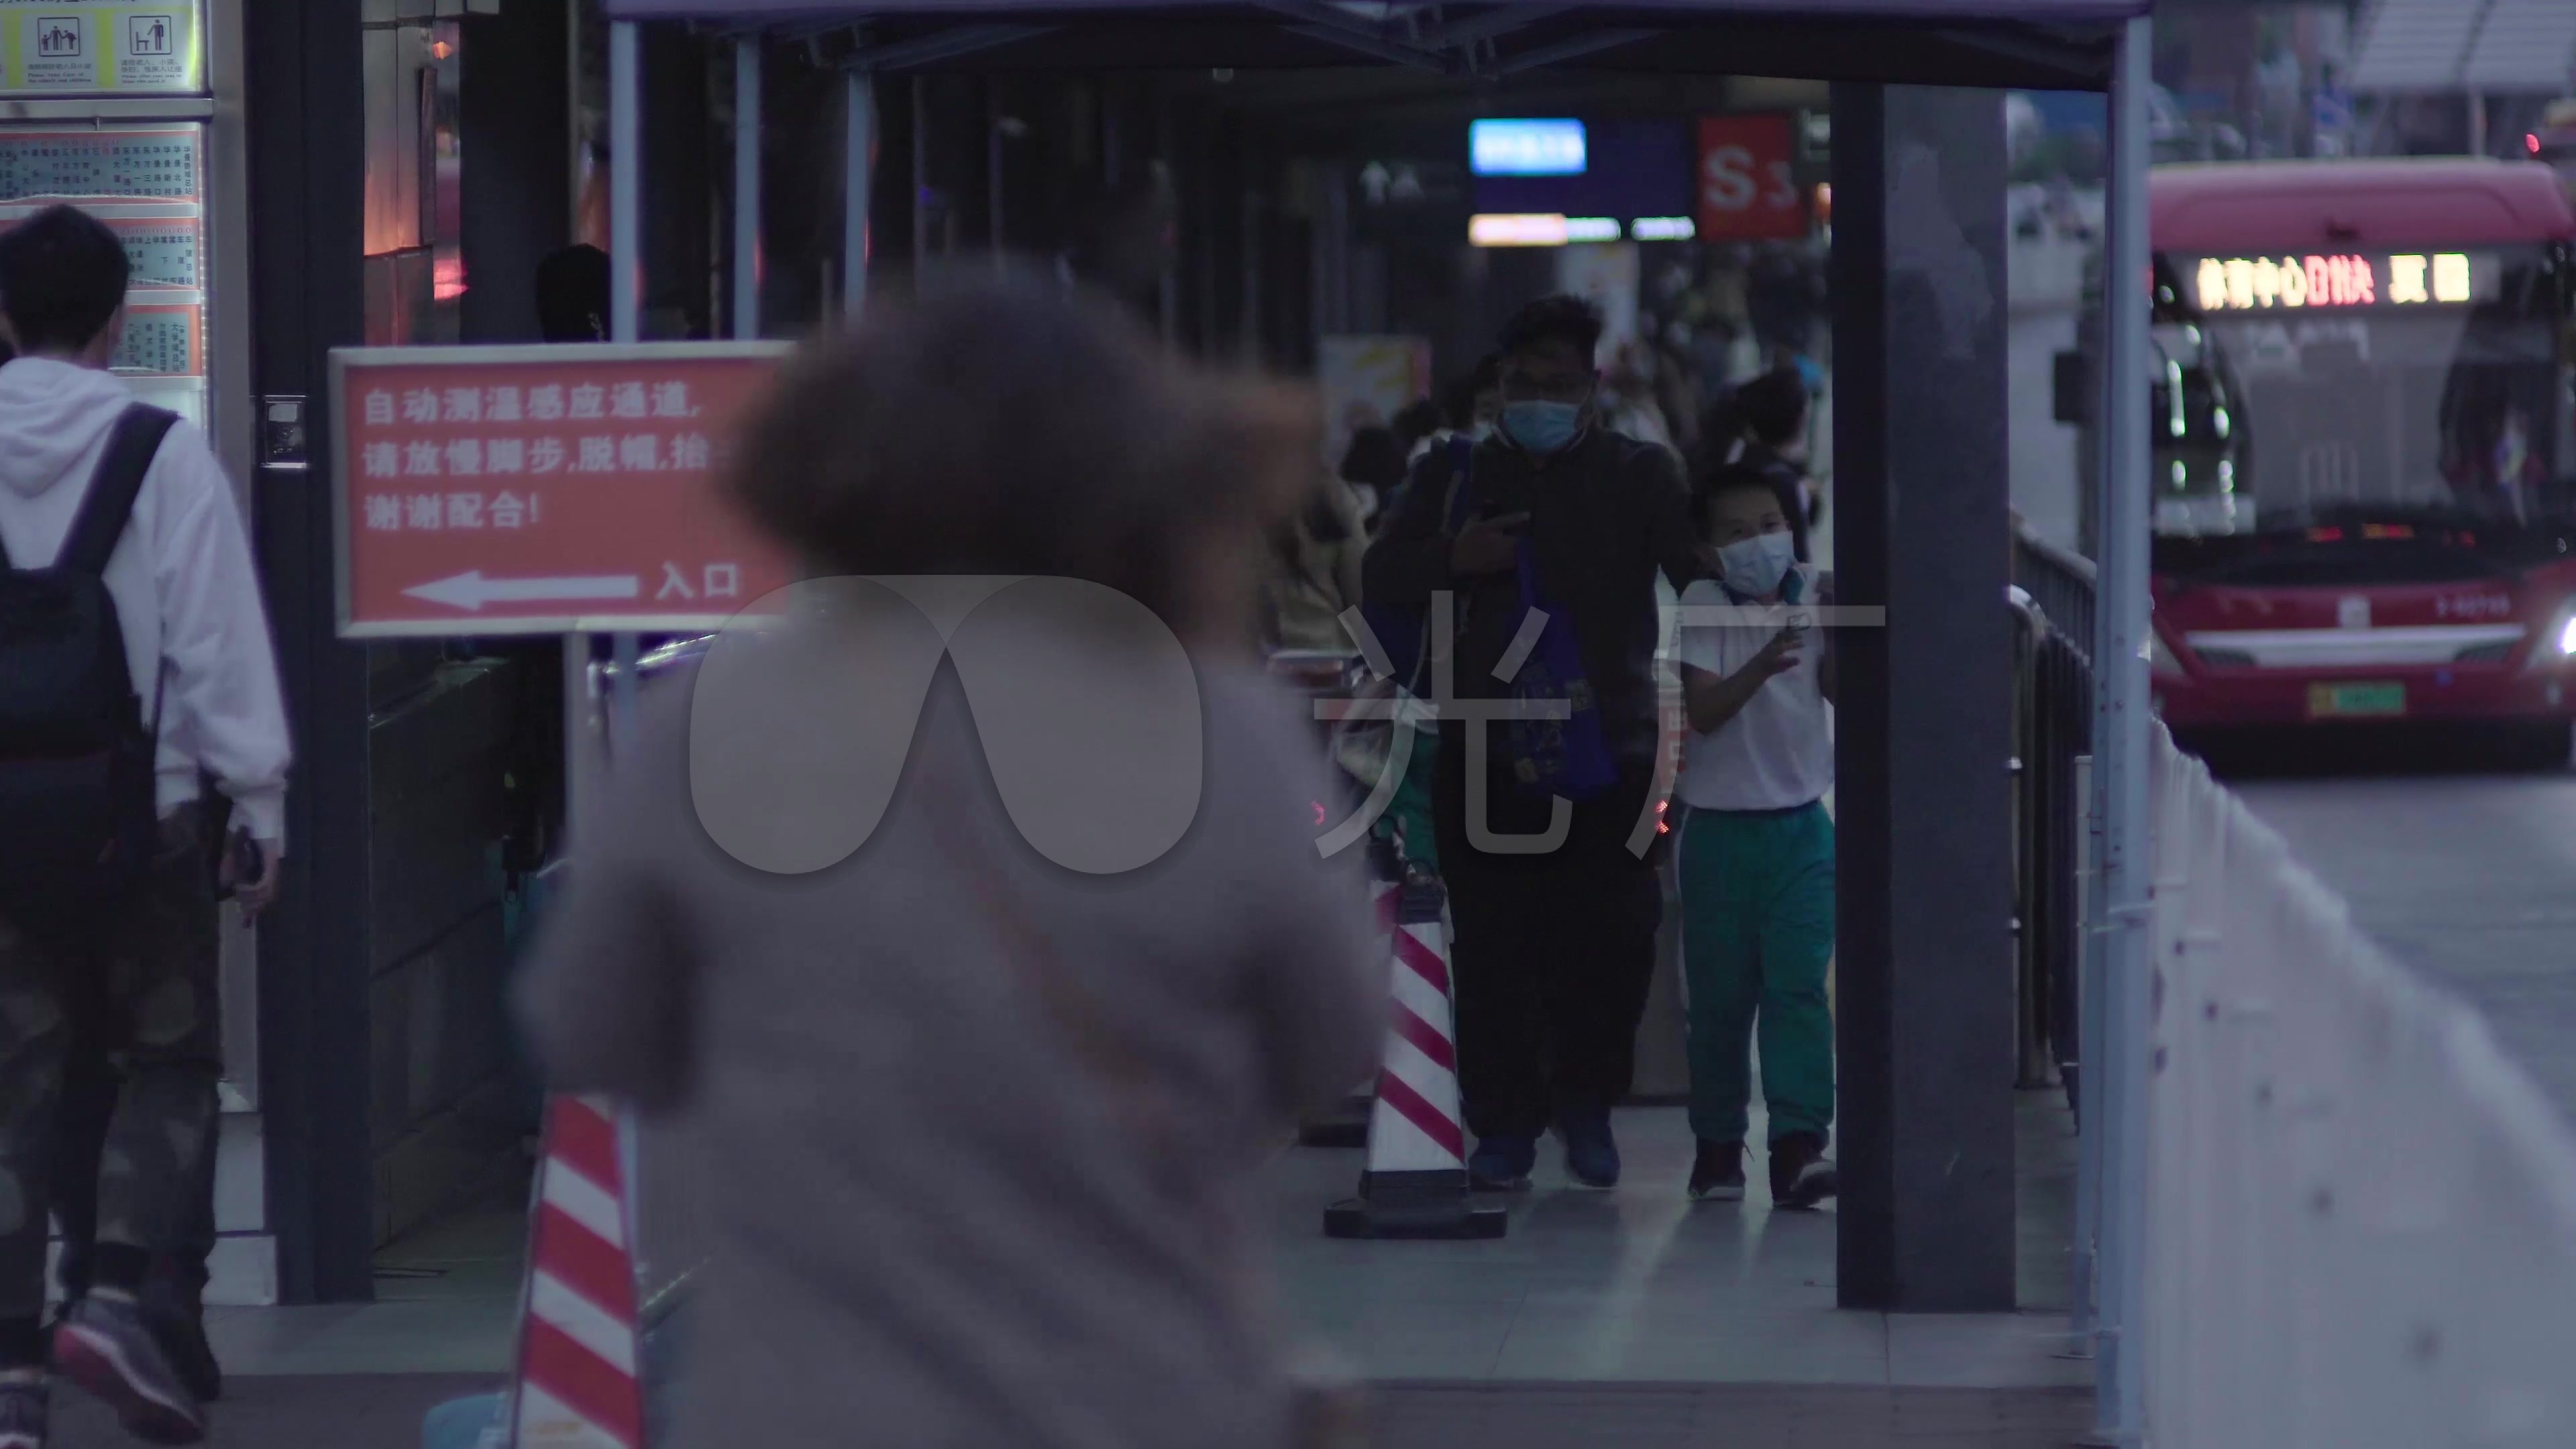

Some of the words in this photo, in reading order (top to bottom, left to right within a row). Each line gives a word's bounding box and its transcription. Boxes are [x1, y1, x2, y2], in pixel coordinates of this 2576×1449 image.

[362, 433, 723, 477] 请放慢脚步,脱帽,抬
[655, 561, 739, 600] 入口
